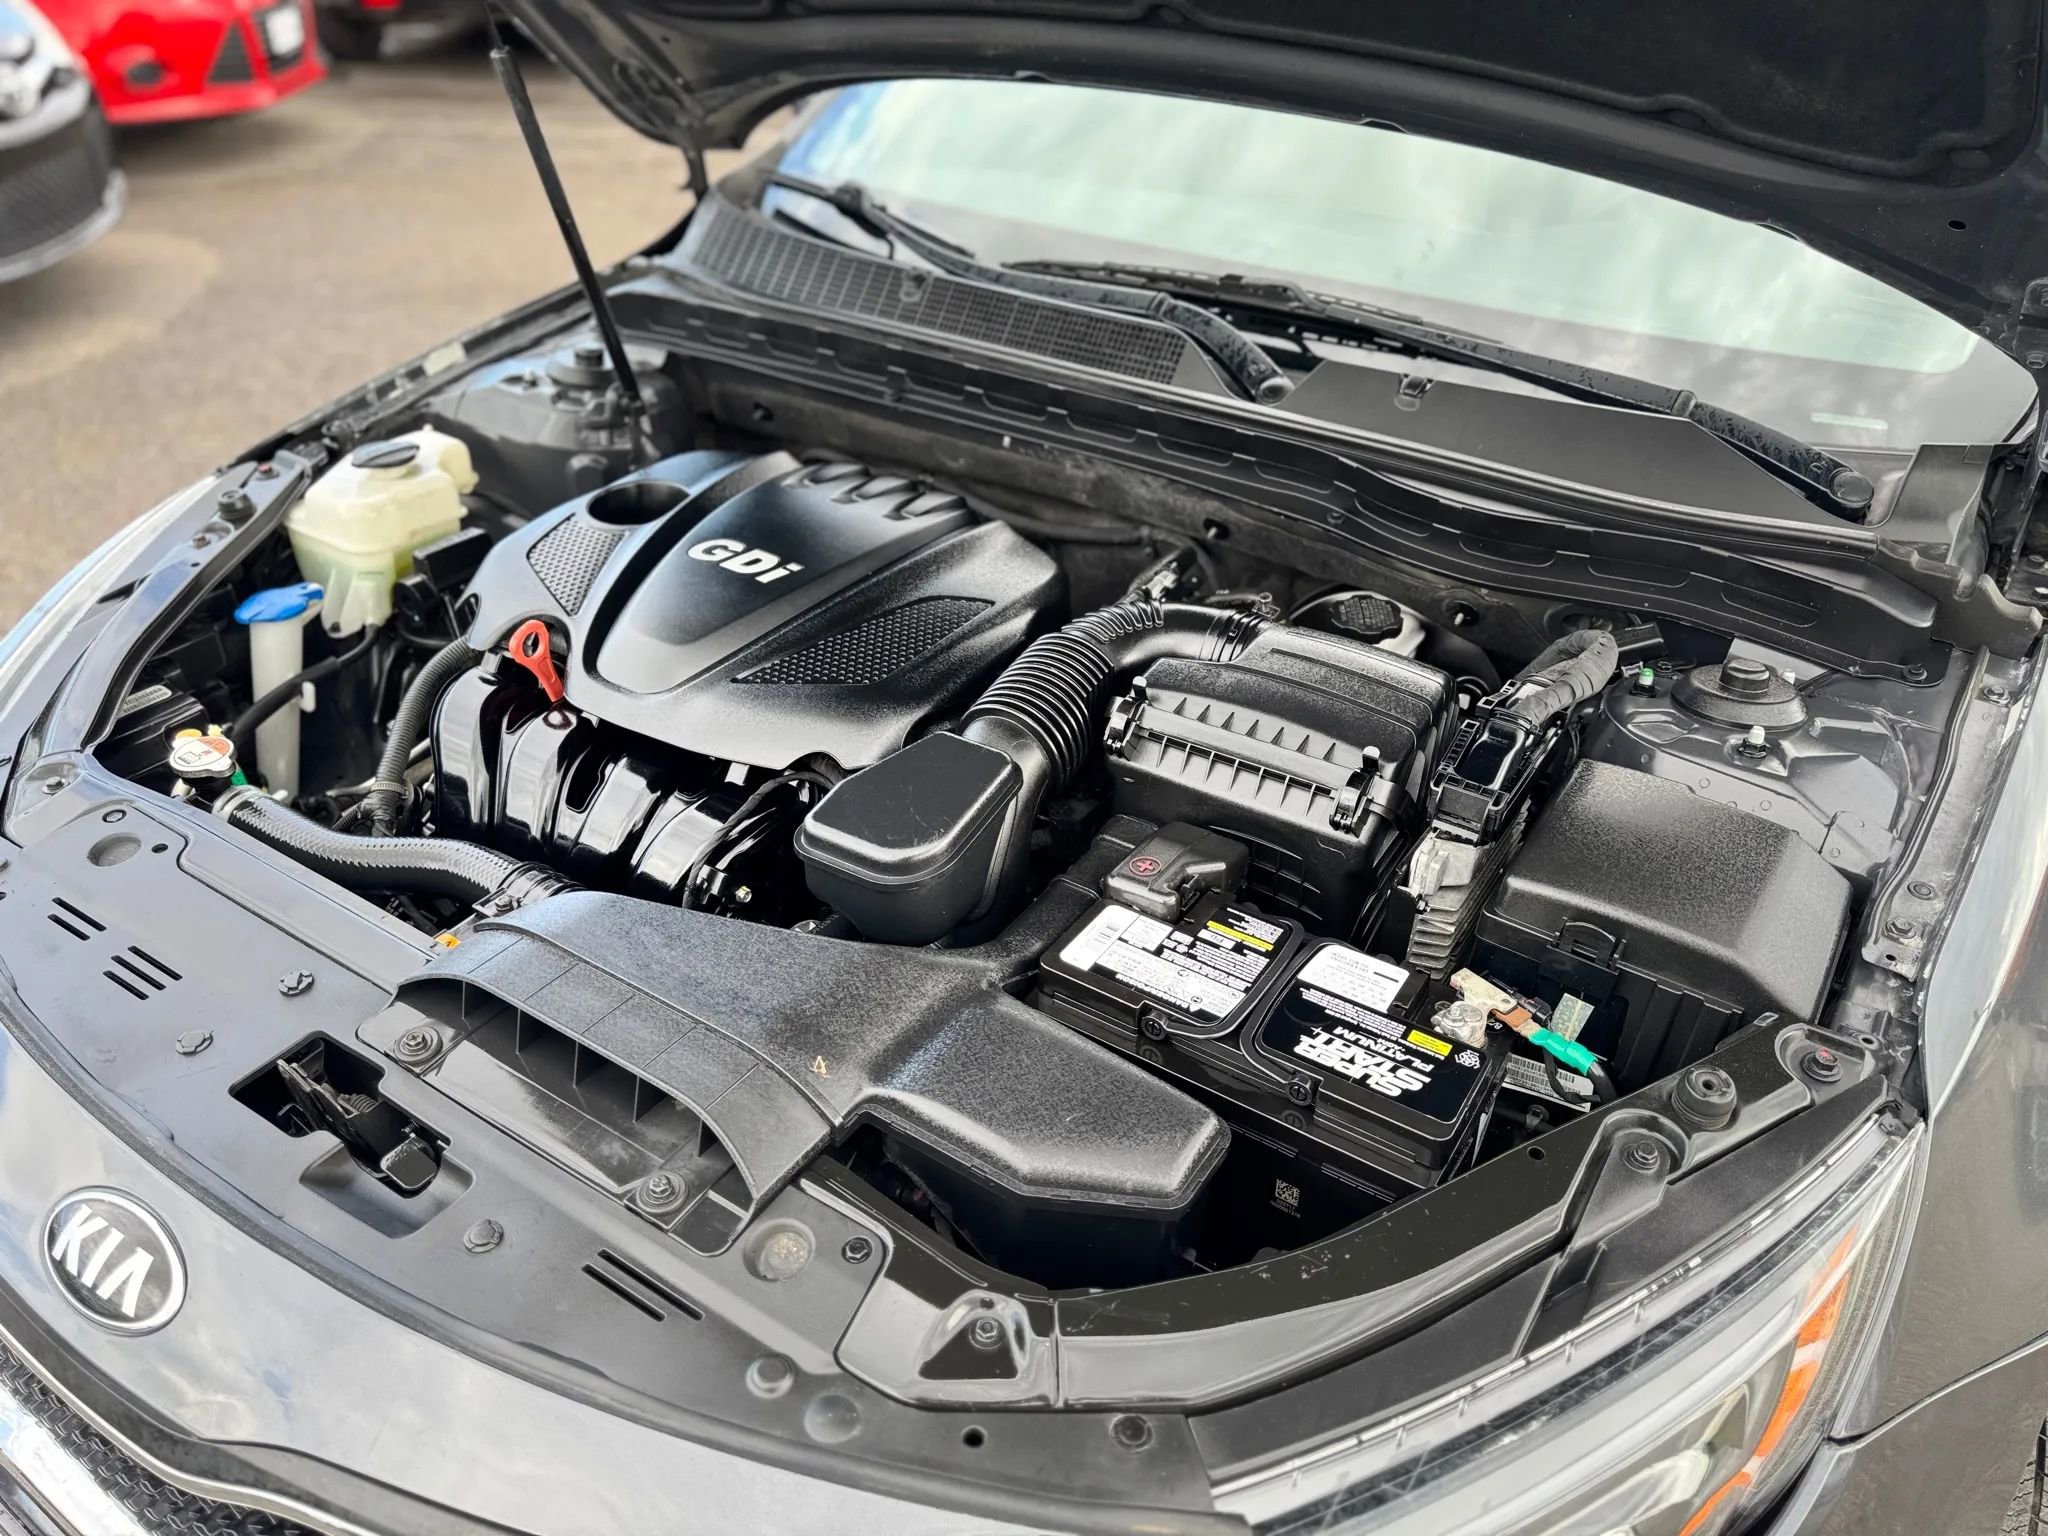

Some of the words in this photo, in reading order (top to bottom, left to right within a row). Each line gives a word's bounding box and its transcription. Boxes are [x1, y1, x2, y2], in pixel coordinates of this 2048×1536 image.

[688, 538, 804, 584] GDi
[1293, 1041, 1402, 1097] SUPER
[1300, 1028, 1432, 1091] START
[1333, 1026, 1435, 1072] PLATINUM
[51, 1203, 155, 1318] KIA
